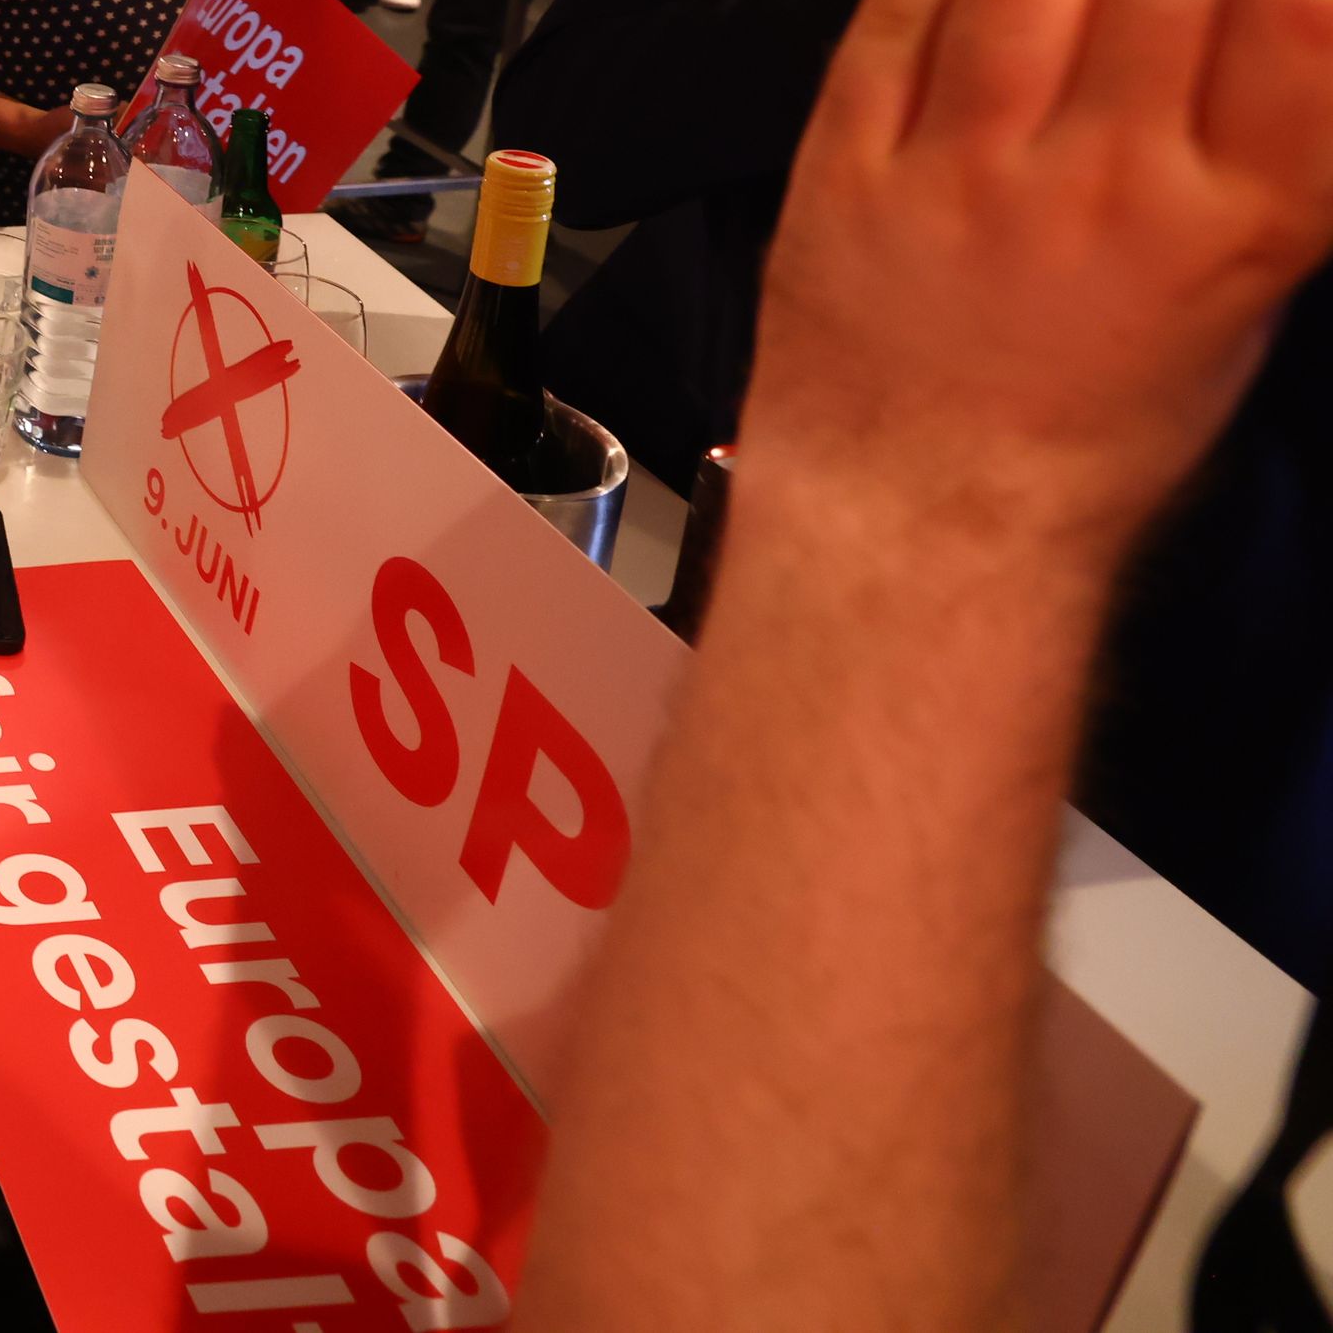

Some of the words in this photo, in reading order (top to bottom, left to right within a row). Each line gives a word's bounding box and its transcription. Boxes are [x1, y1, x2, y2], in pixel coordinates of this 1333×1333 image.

[143, 468, 167, 530] 9.
[175, 515, 260, 637] JUNI
[350, 556, 632, 911] SP
[110, 805, 511, 1333] Europa
